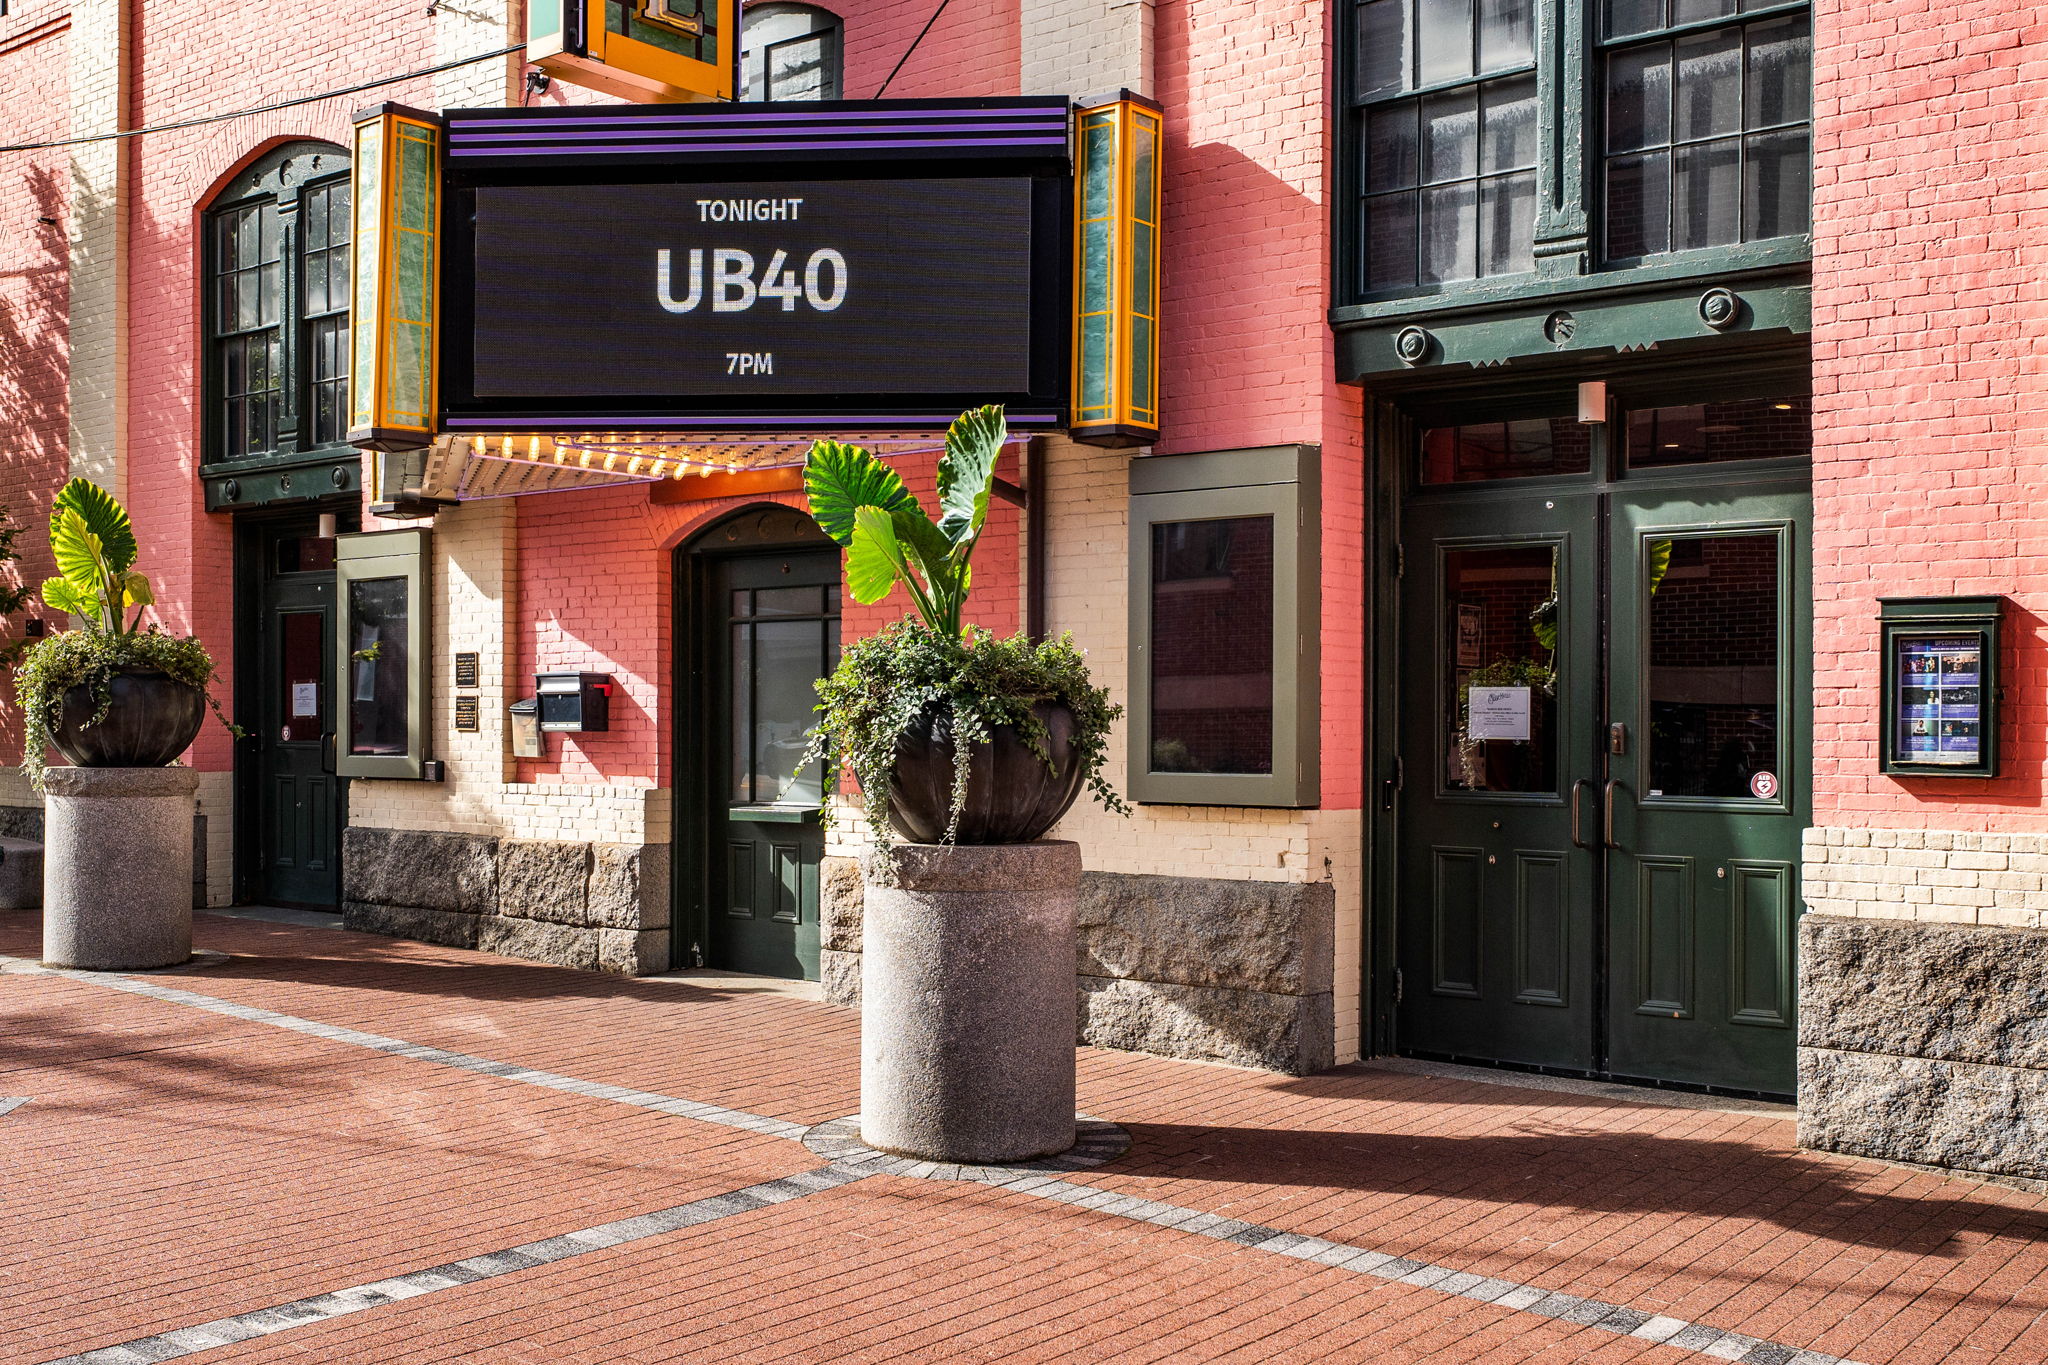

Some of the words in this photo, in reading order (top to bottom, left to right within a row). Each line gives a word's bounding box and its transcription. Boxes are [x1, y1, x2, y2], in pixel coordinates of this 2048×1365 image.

[696, 198, 803, 221] TONIGHT
[657, 248, 847, 313] UB40
[726, 353, 773, 375] 7PM
